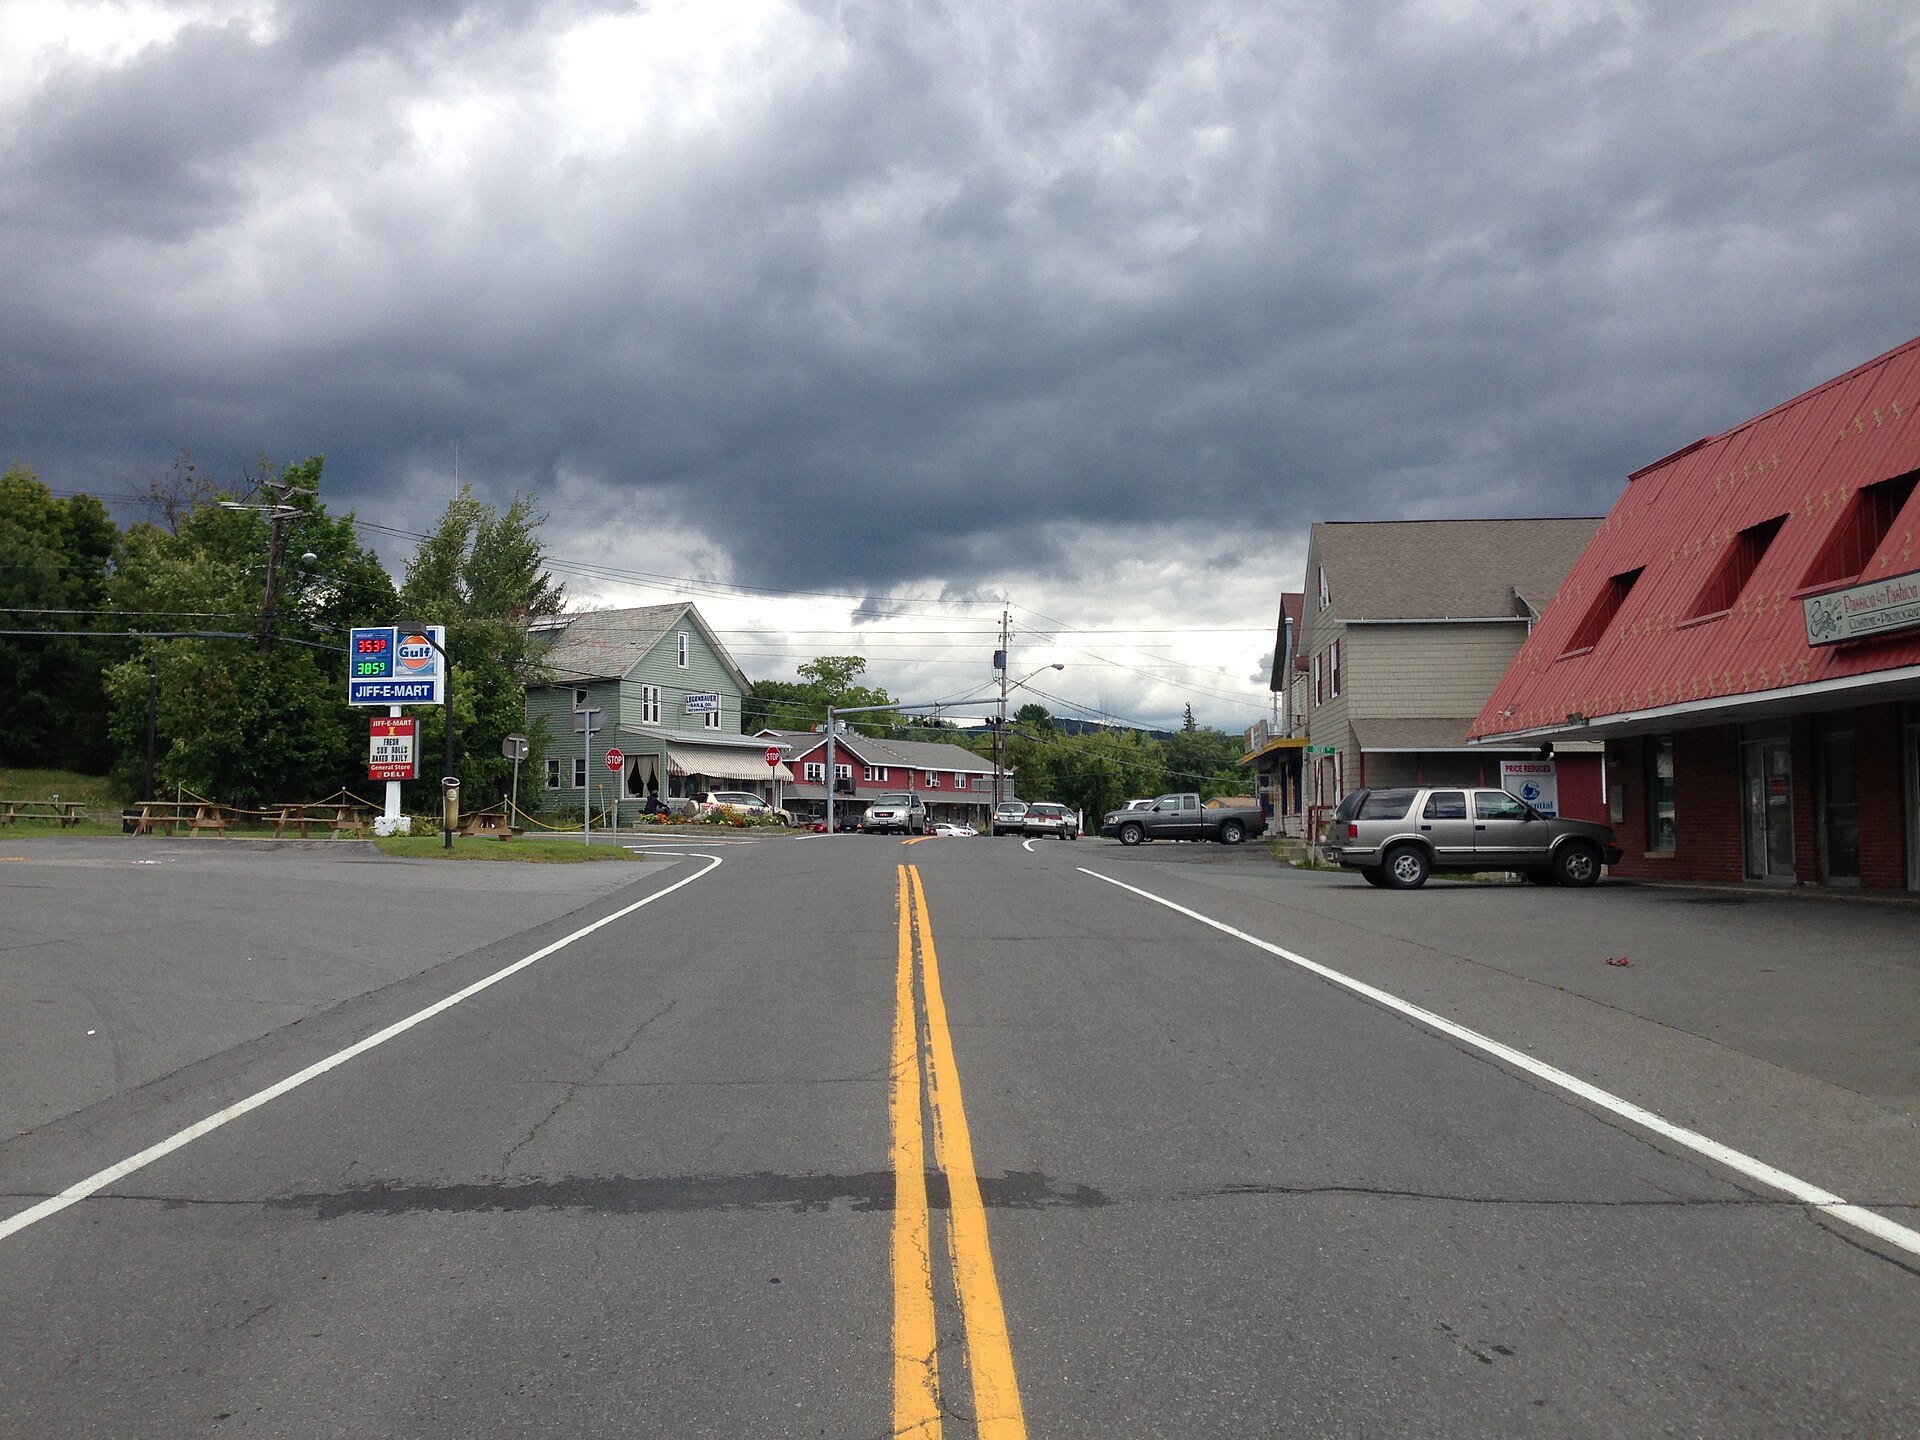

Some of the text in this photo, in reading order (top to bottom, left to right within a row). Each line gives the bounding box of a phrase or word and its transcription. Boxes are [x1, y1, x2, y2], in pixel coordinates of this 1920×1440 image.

[1843, 592, 1876, 613] Passion
[1885, 581, 1919, 604] Fashion
[398, 646, 431, 658] Gulf
[355, 685, 430, 698] JIFF-E-MART
[383, 738, 399, 746] FRESH
[377, 746, 408, 754] SUB ROLLS
[607, 755, 622, 764] STOP
[766, 752, 779, 761] STOP
[1504, 765, 1552, 773] PRICE REDUCED
